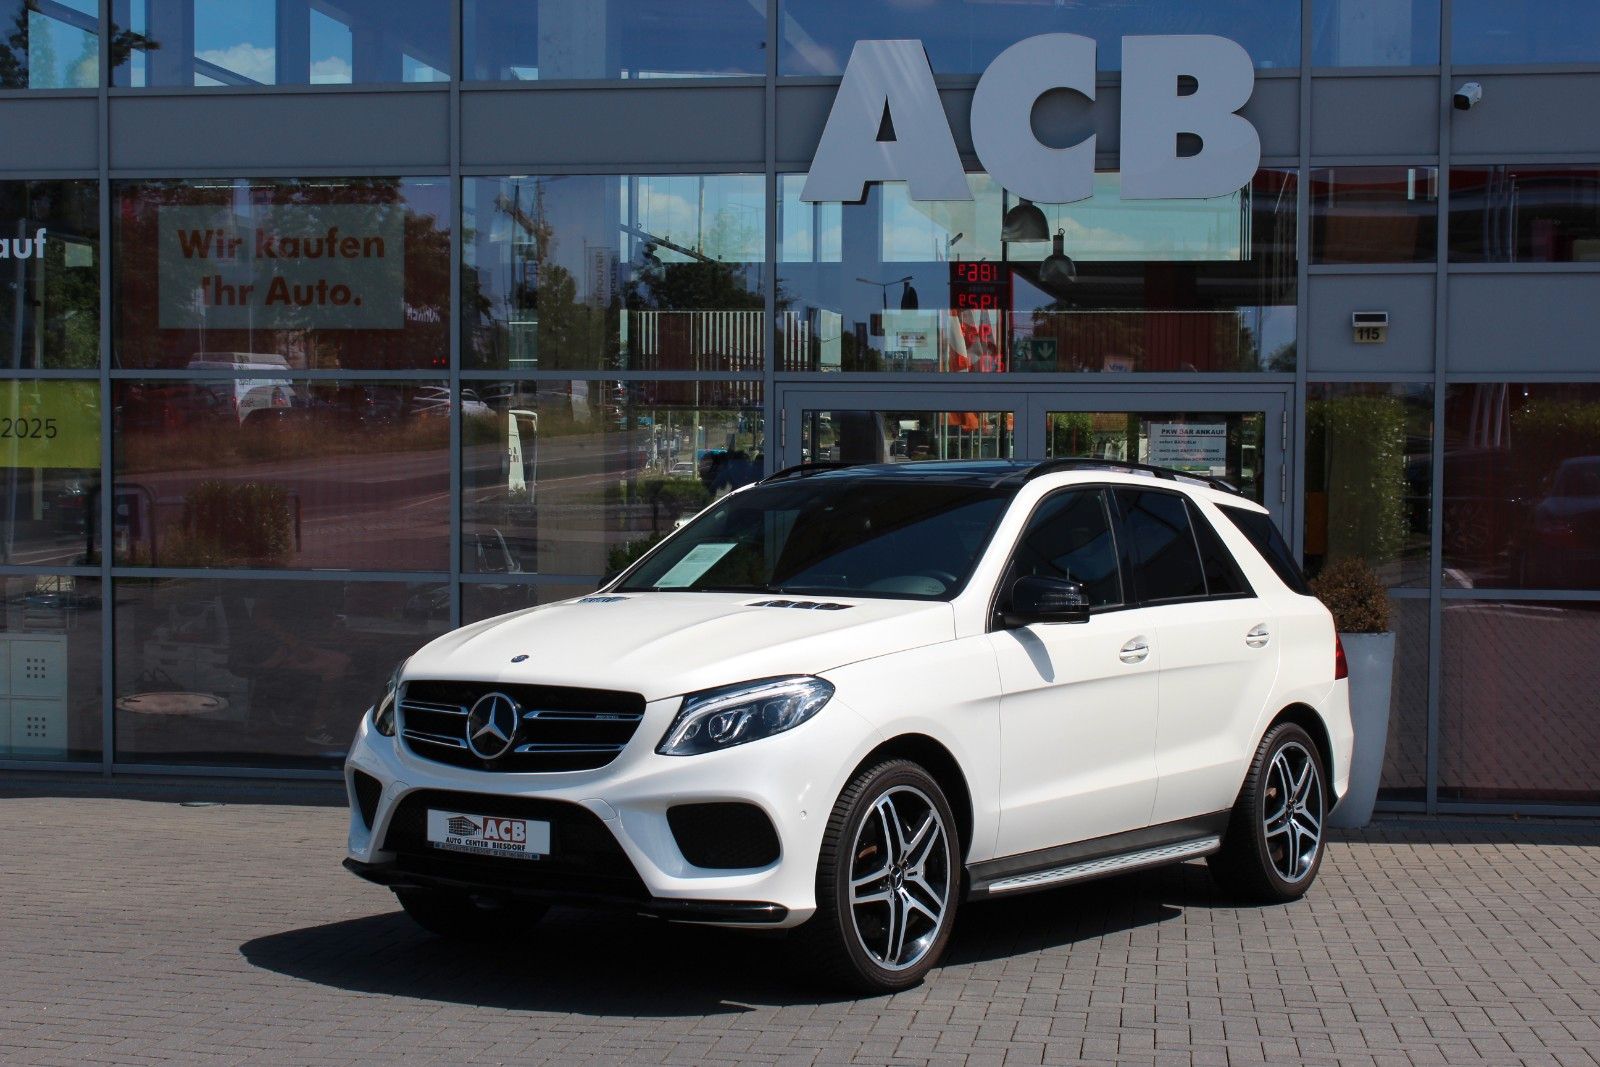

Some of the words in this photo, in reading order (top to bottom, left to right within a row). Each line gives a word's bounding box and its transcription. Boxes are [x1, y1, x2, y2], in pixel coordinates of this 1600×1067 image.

[801, 33, 1261, 204] ACB
[177, 229, 243, 258] Wir
[255, 227, 385, 258] kaufen
[202, 275, 254, 306] Ihr
[265, 276, 363, 306] Auto.
[1357, 327, 1380, 341] 115
[1, 417, 58, 439] 2025
[484, 819, 526, 841] ACB
[445, 837, 462, 845] AUTO
[465, 838, 489, 848] CENTER
[492, 841, 526, 852] BIESDORF
